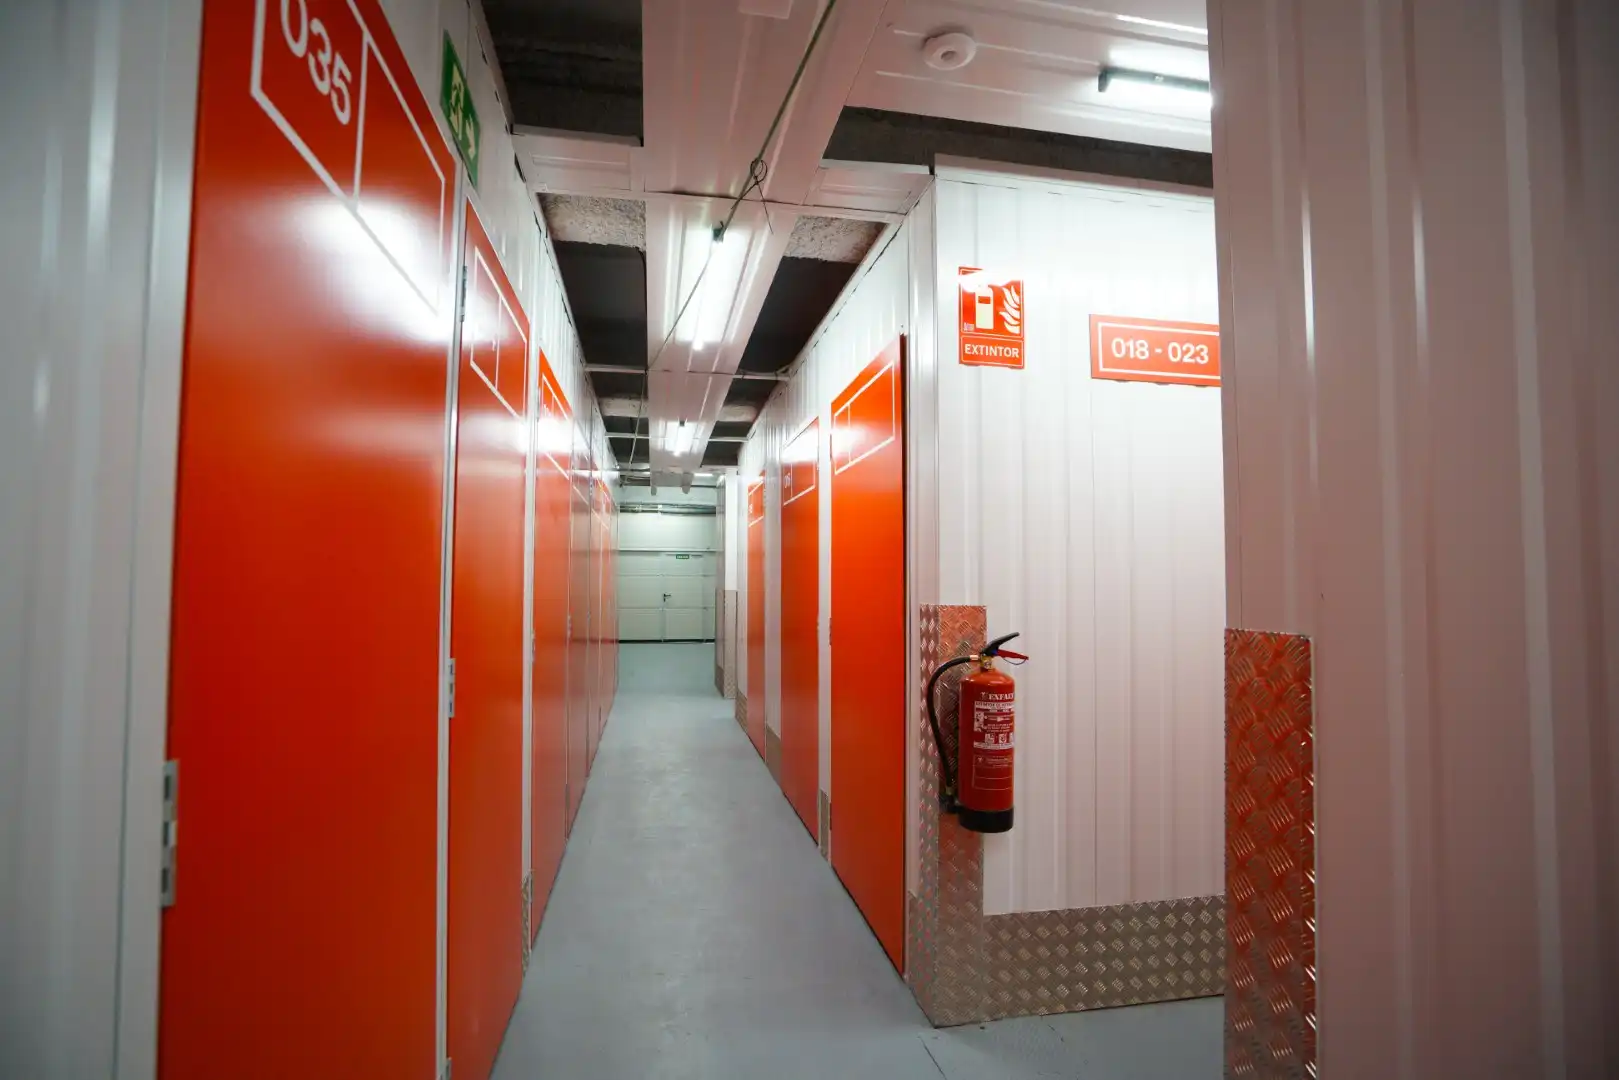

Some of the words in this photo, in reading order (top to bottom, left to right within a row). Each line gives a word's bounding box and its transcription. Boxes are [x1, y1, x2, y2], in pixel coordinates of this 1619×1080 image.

[280, 0, 352, 126] 035
[964, 343, 1020, 358] EXTINTOR
[1111, 337, 1150, 360] 018
[1167, 341, 1210, 365] 023
